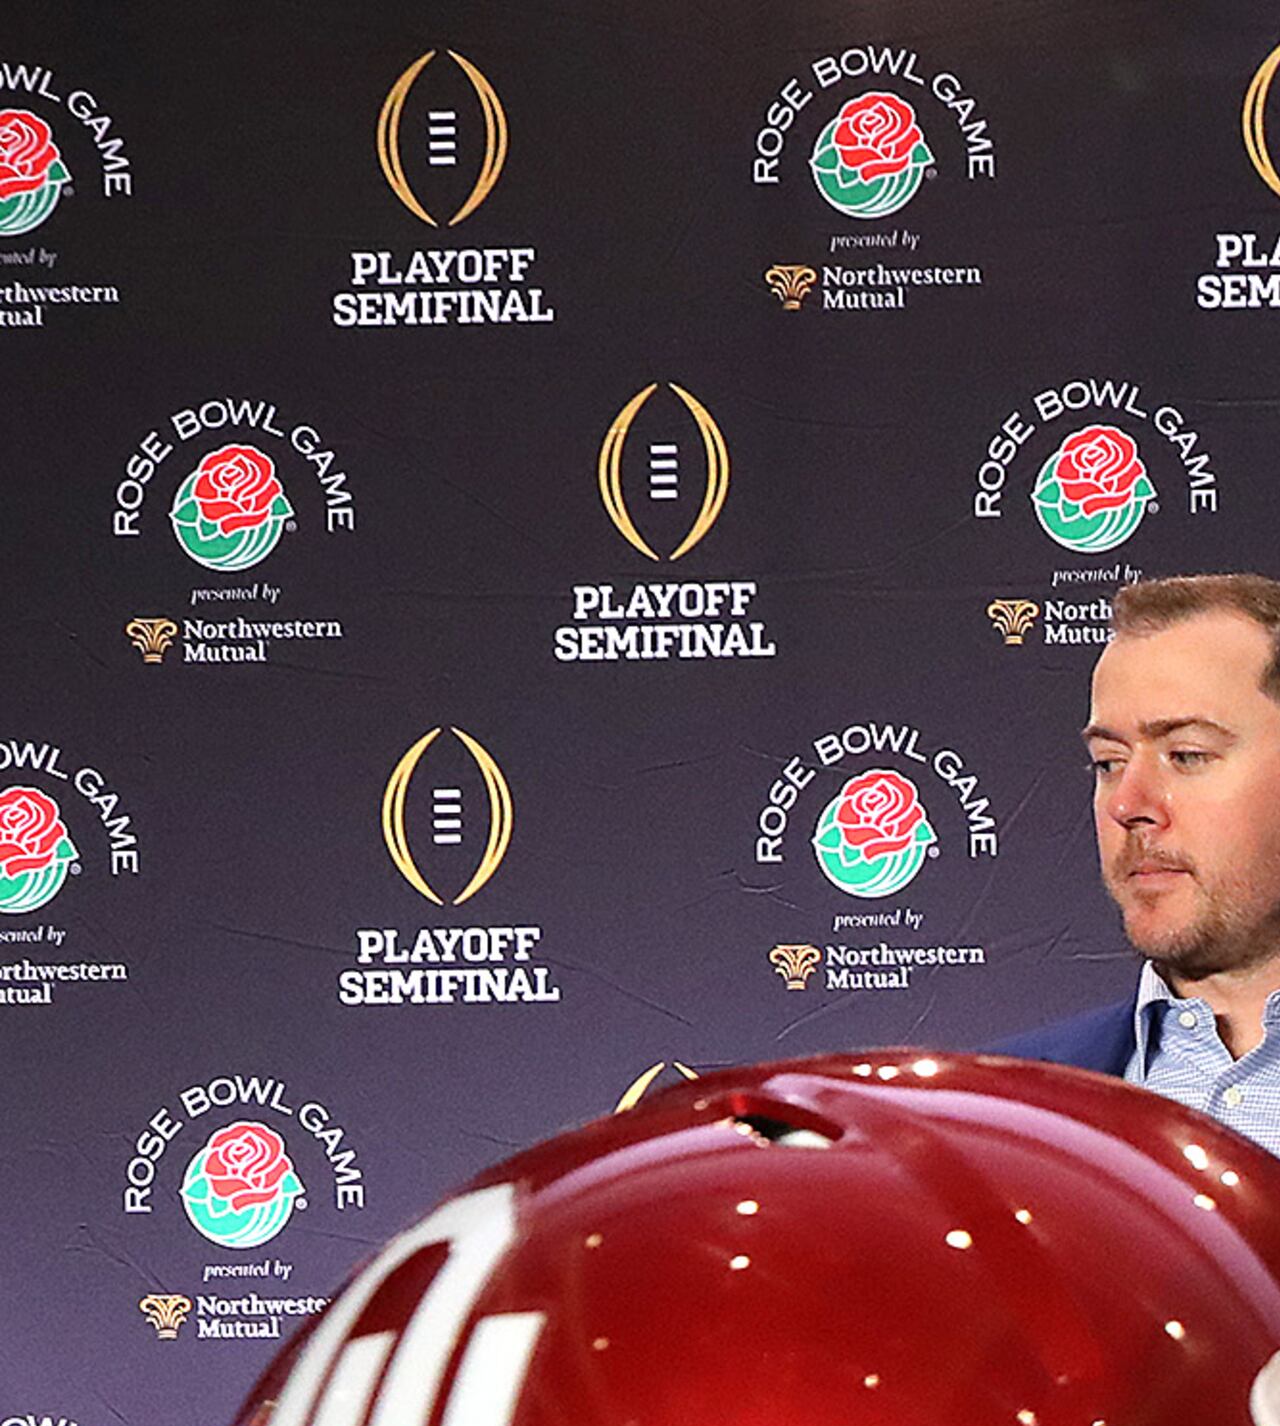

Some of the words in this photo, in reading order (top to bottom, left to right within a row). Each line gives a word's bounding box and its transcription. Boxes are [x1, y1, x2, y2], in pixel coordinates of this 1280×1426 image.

[754, 79, 812, 183] ROSE
[812, 46, 924, 88] BOWL
[933, 73, 994, 179] GAME
[68, 91, 131, 197] GAME
[830, 230, 897, 252] presented
[902, 230, 920, 250] by
[39, 248, 57, 268] by
[351, 248, 534, 285] PLAYOFF
[823, 264, 981, 286] Northwestern
[0, 282, 119, 303] thwestern
[822, 286, 906, 310] Mutual
[333, 289, 553, 326] SEMIFINAL
[975, 412, 1035, 517] ROSE
[1034, 379, 1147, 421] BOWL
[1155, 407, 1216, 513] GAME
[114, 431, 173, 535] ROSE
[171, 398, 284, 440] BOWL
[292, 426, 354, 532] GAME
[1052, 565, 1120, 587] presented
[1125, 565, 1142, 585] by
[191, 584, 258, 605] presented
[262, 583, 280, 604] by
[573, 582, 756, 619] PLAYOFF
[183, 617, 342, 639] Northwestern
[1044, 624, 1116, 644] Mutua
[183, 639, 267, 662] Mutual
[555, 623, 776, 661] SEMIFINAL
[757, 757, 816, 862] ROSE
[814, 723, 926, 765] BOWL
[935, 751, 996, 858] GAME
[75, 768, 138, 875] GAME
[833, 909, 901, 931] presented
[905, 909, 923, 930] by
[47, 926, 66, 945] by
[357, 928, 540, 963] PLAYOFF
[826, 943, 985, 965] Northwestern
[0, 960, 127, 980] rthwestern
[826, 966, 910, 989] Mutual
[0, 982, 52, 1003] tual
[340, 968, 559, 1004] SEMIFINAL
[125, 1108, 182, 1212] ROSE
[180, 1076, 292, 1117] BOWL
[300, 1103, 363, 1209] GAME
[203, 1260, 270, 1281] presented
[274, 1260, 292, 1280] by
[196, 1293, 331, 1315] Northweste
[197, 1316, 281, 1338] Mutual
